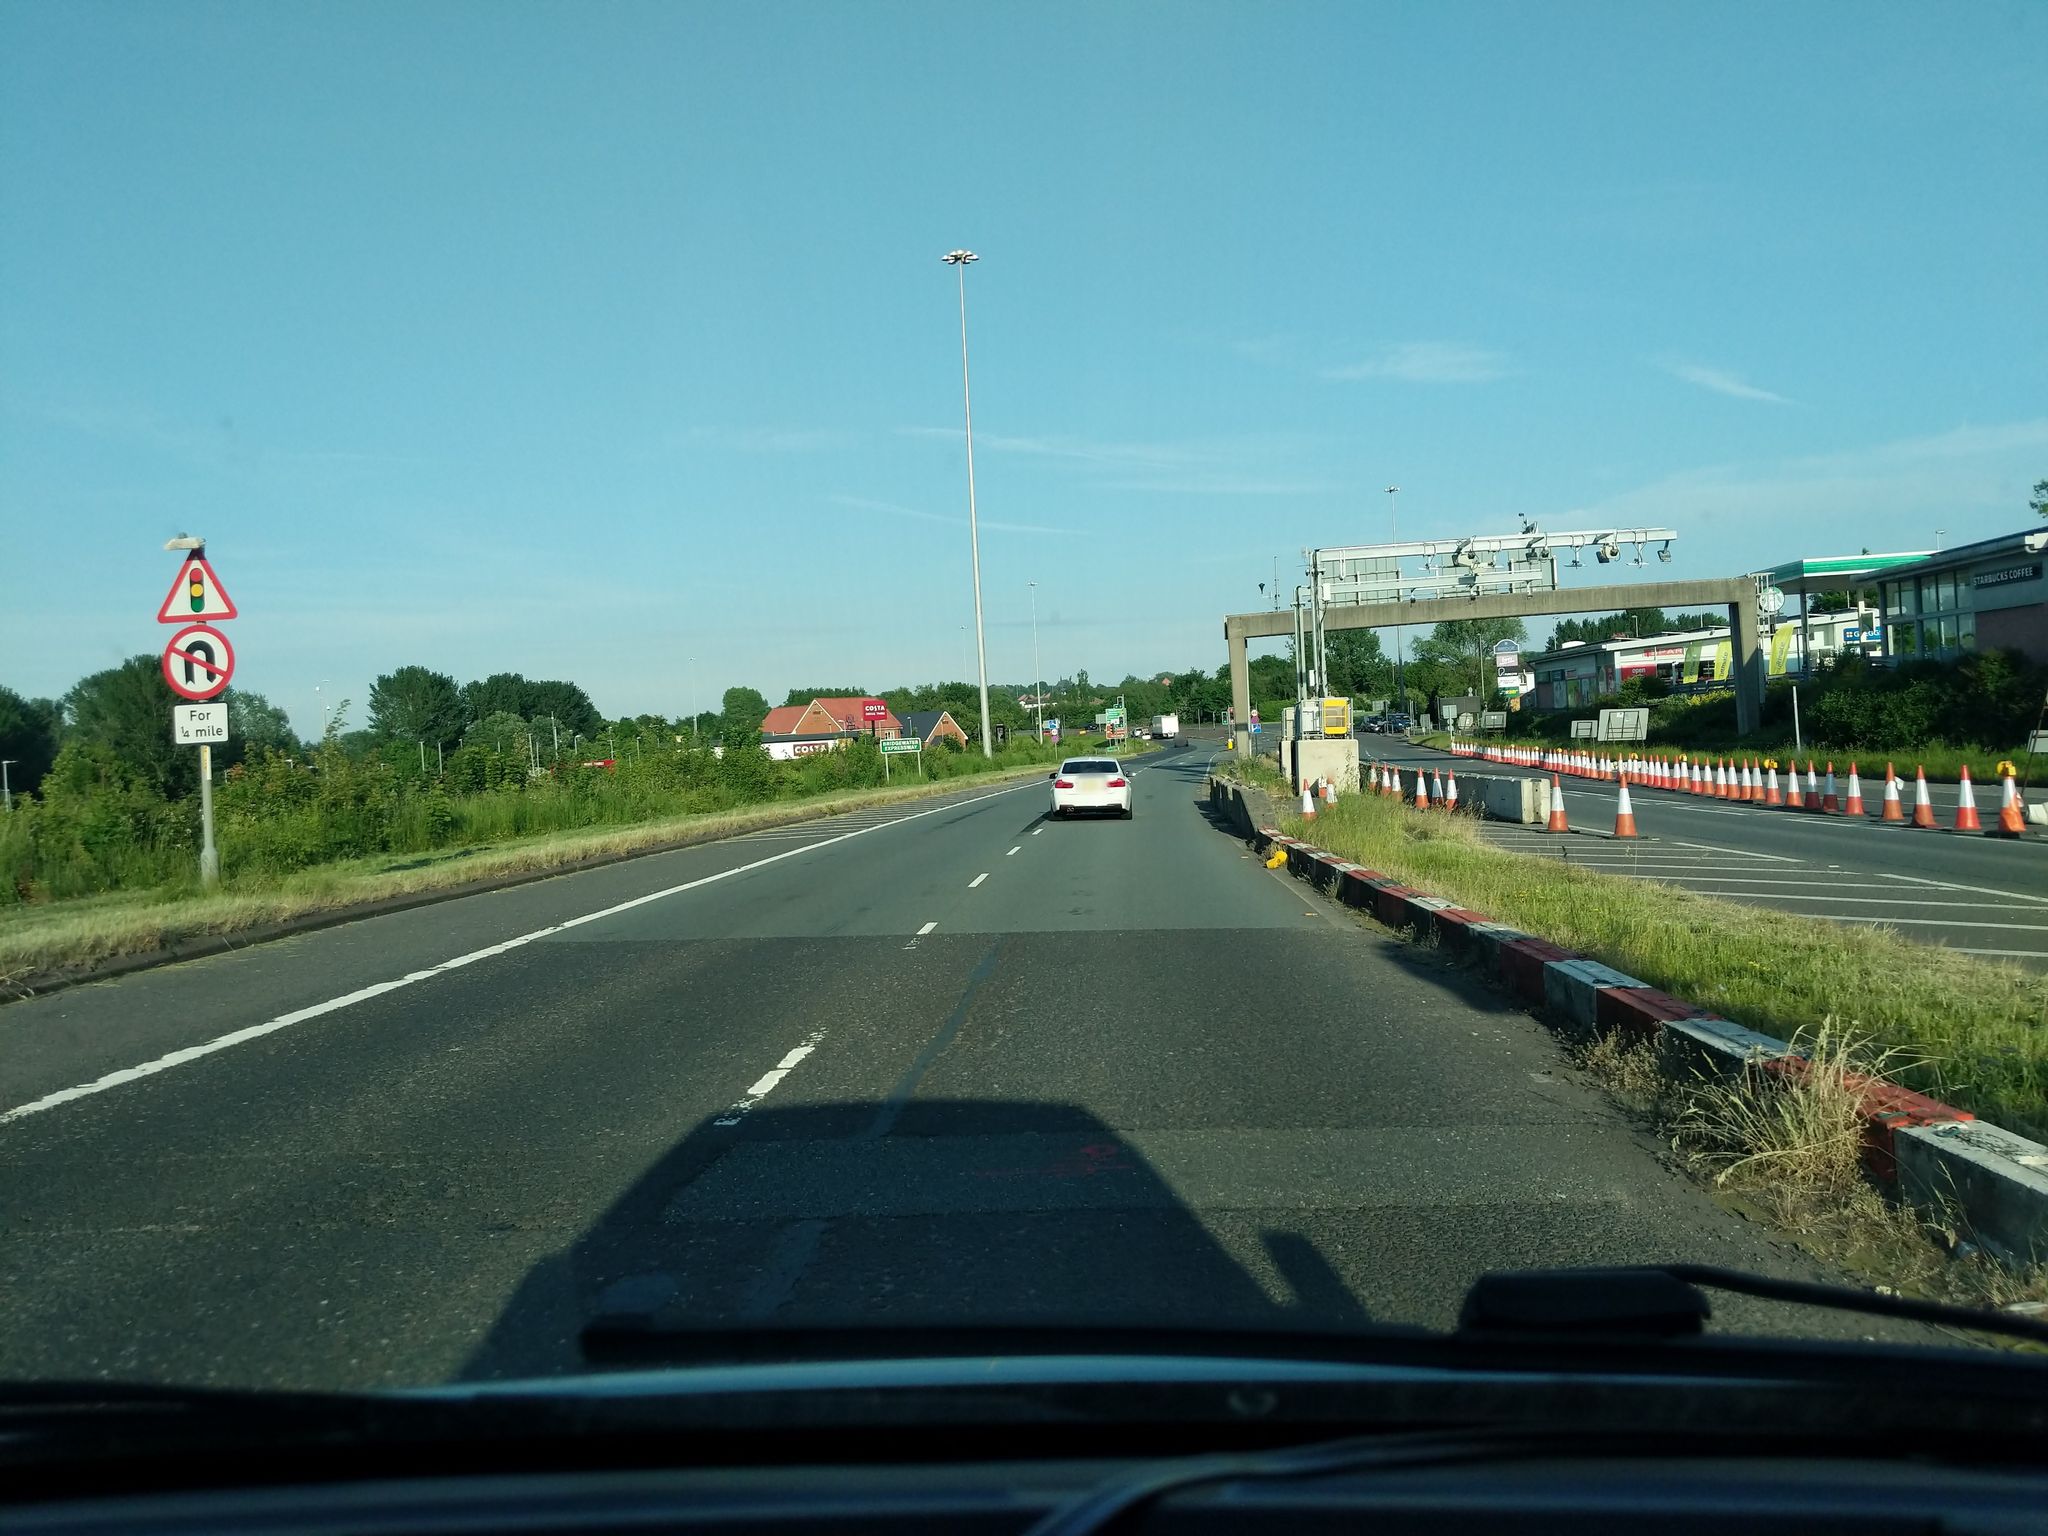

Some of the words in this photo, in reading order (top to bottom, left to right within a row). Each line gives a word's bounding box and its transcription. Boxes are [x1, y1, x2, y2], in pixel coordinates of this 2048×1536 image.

[1973, 572, 2008, 585] STARBUCKS
[2009, 567, 2033, 579] COFFEE
[190, 710, 211, 721] For
[196, 726, 223, 737] mile
